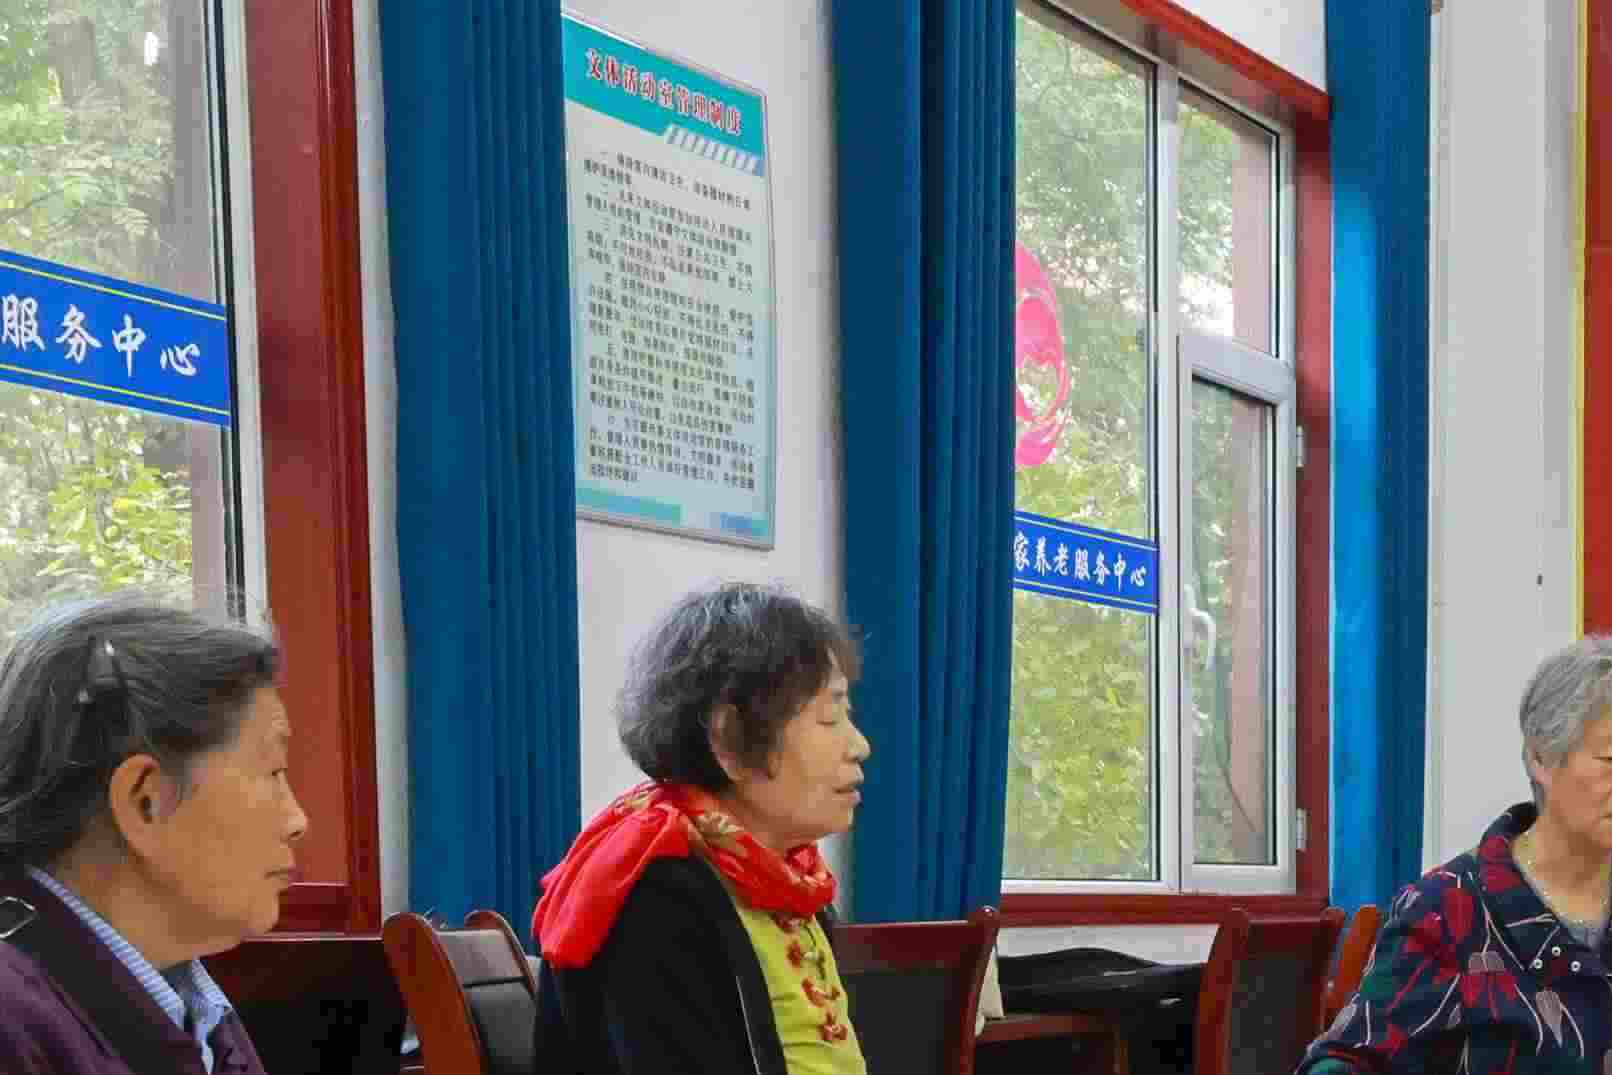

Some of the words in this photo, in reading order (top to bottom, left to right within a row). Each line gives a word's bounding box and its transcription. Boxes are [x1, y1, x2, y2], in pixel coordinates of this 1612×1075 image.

[1, 294, 201, 377] 服务中心
[1013, 531, 1148, 592] 家养老服务中心
